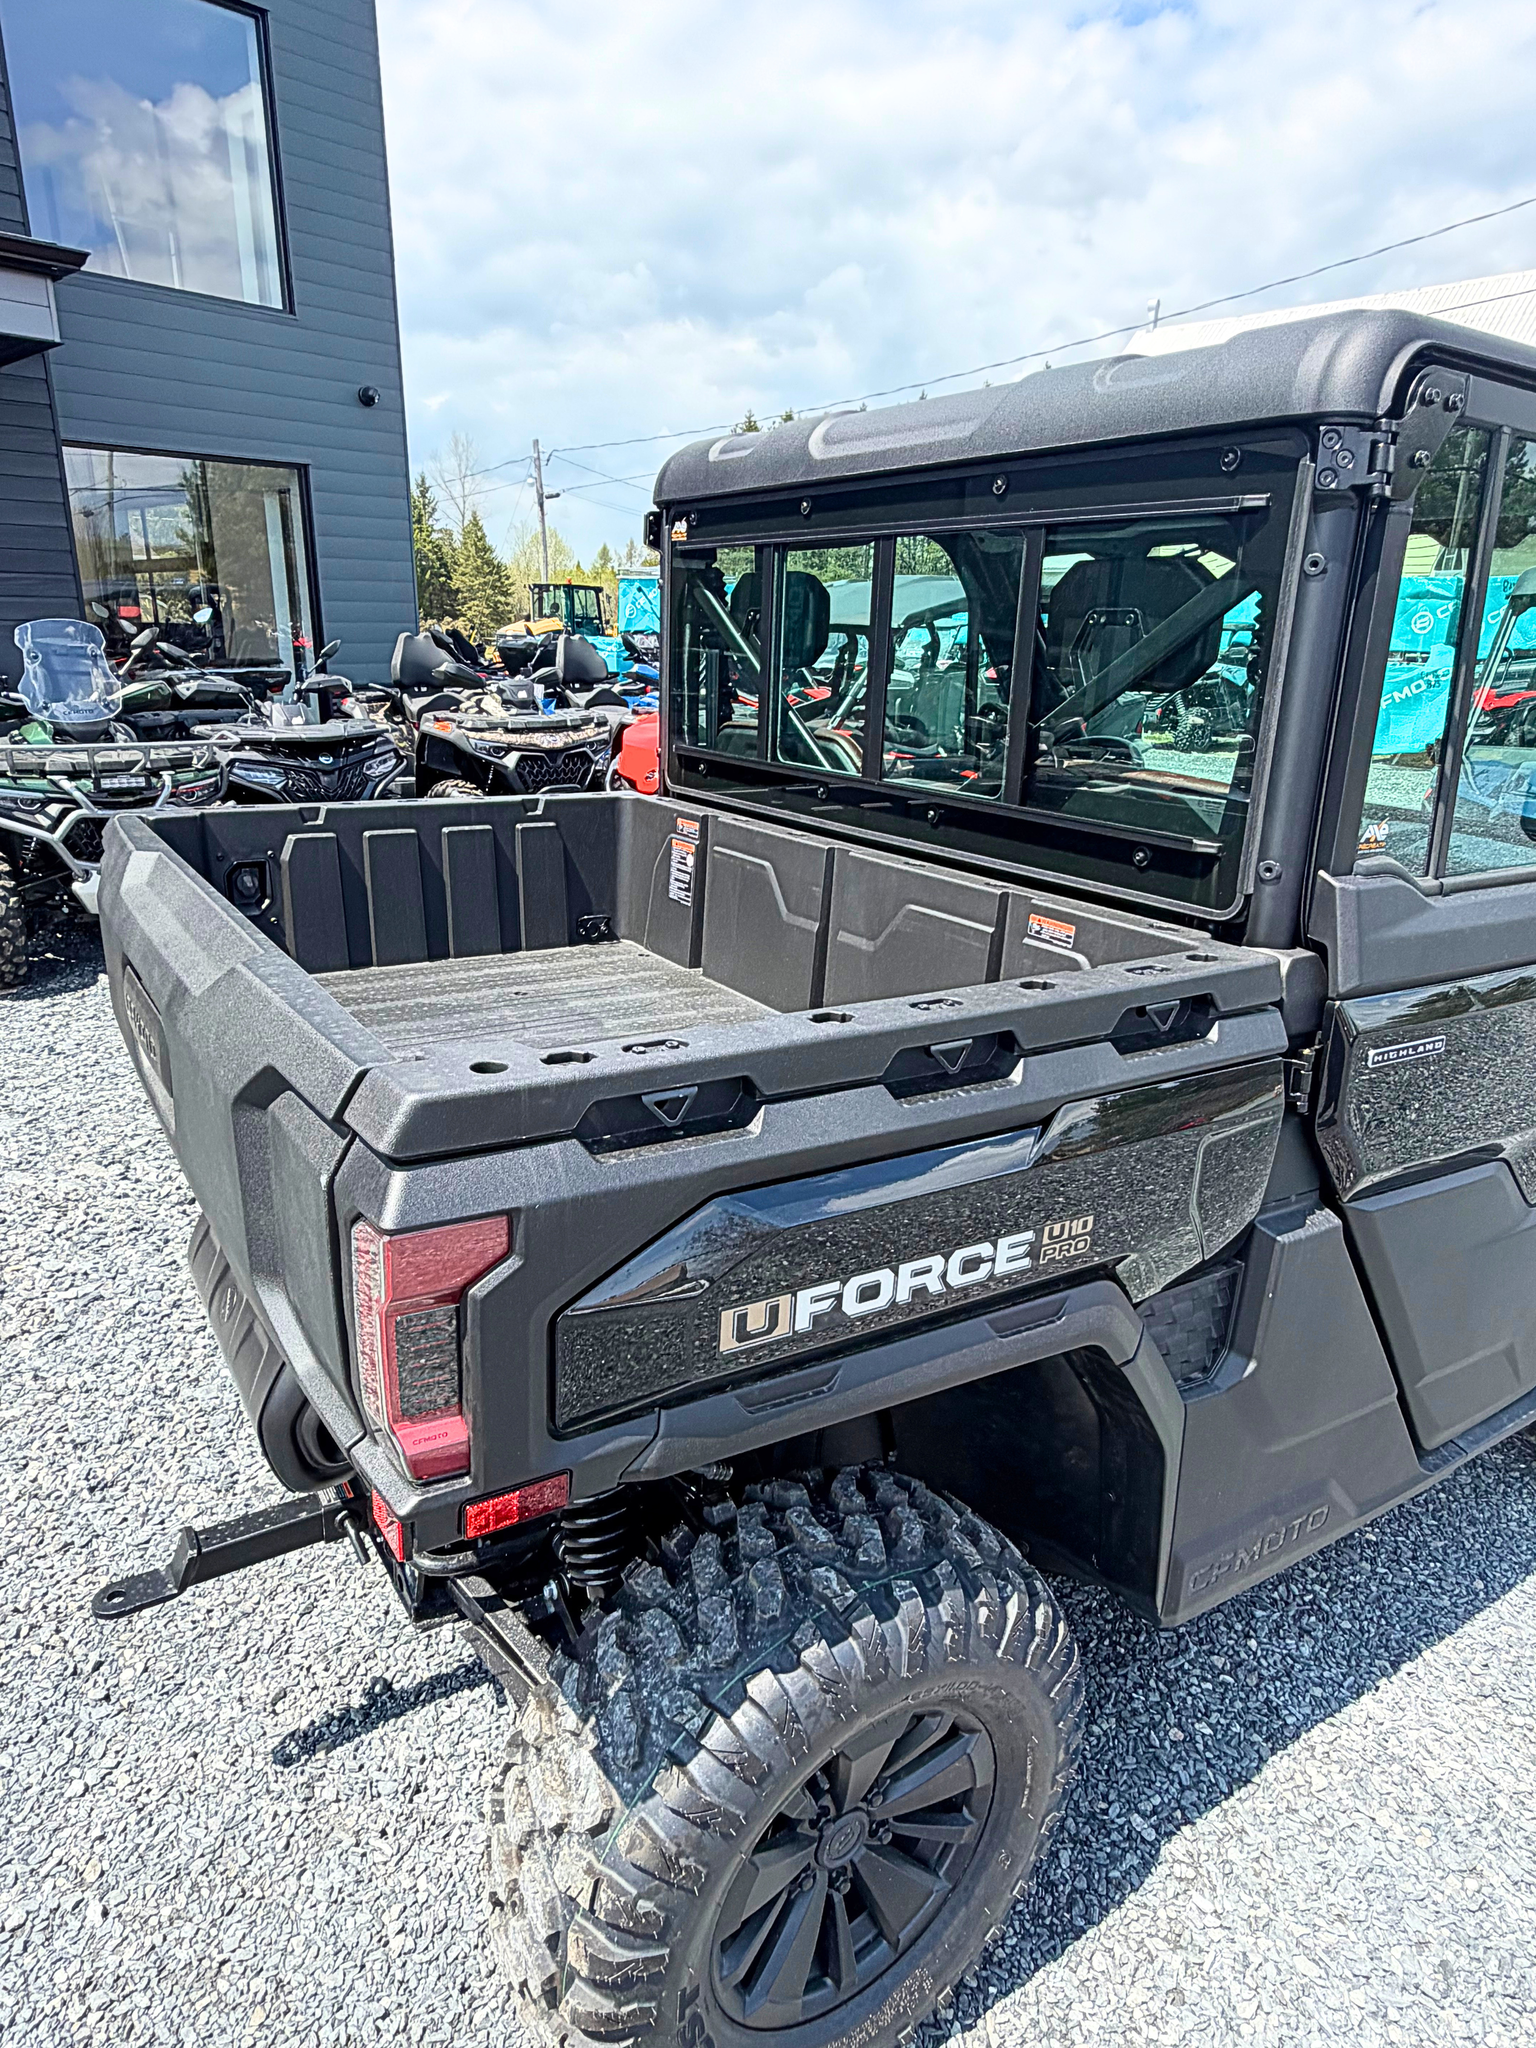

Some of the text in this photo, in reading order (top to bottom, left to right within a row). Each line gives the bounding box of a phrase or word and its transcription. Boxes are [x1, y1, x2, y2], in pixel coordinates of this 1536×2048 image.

[1373, 1041, 1443, 1063] HIGHLAND
[1042, 1215, 1094, 1245] U10
[1039, 1235, 1091, 1265] PRO
[412, 1431, 449, 1446] CFMOTO
[1189, 1503, 1331, 1595] CFMOTO
